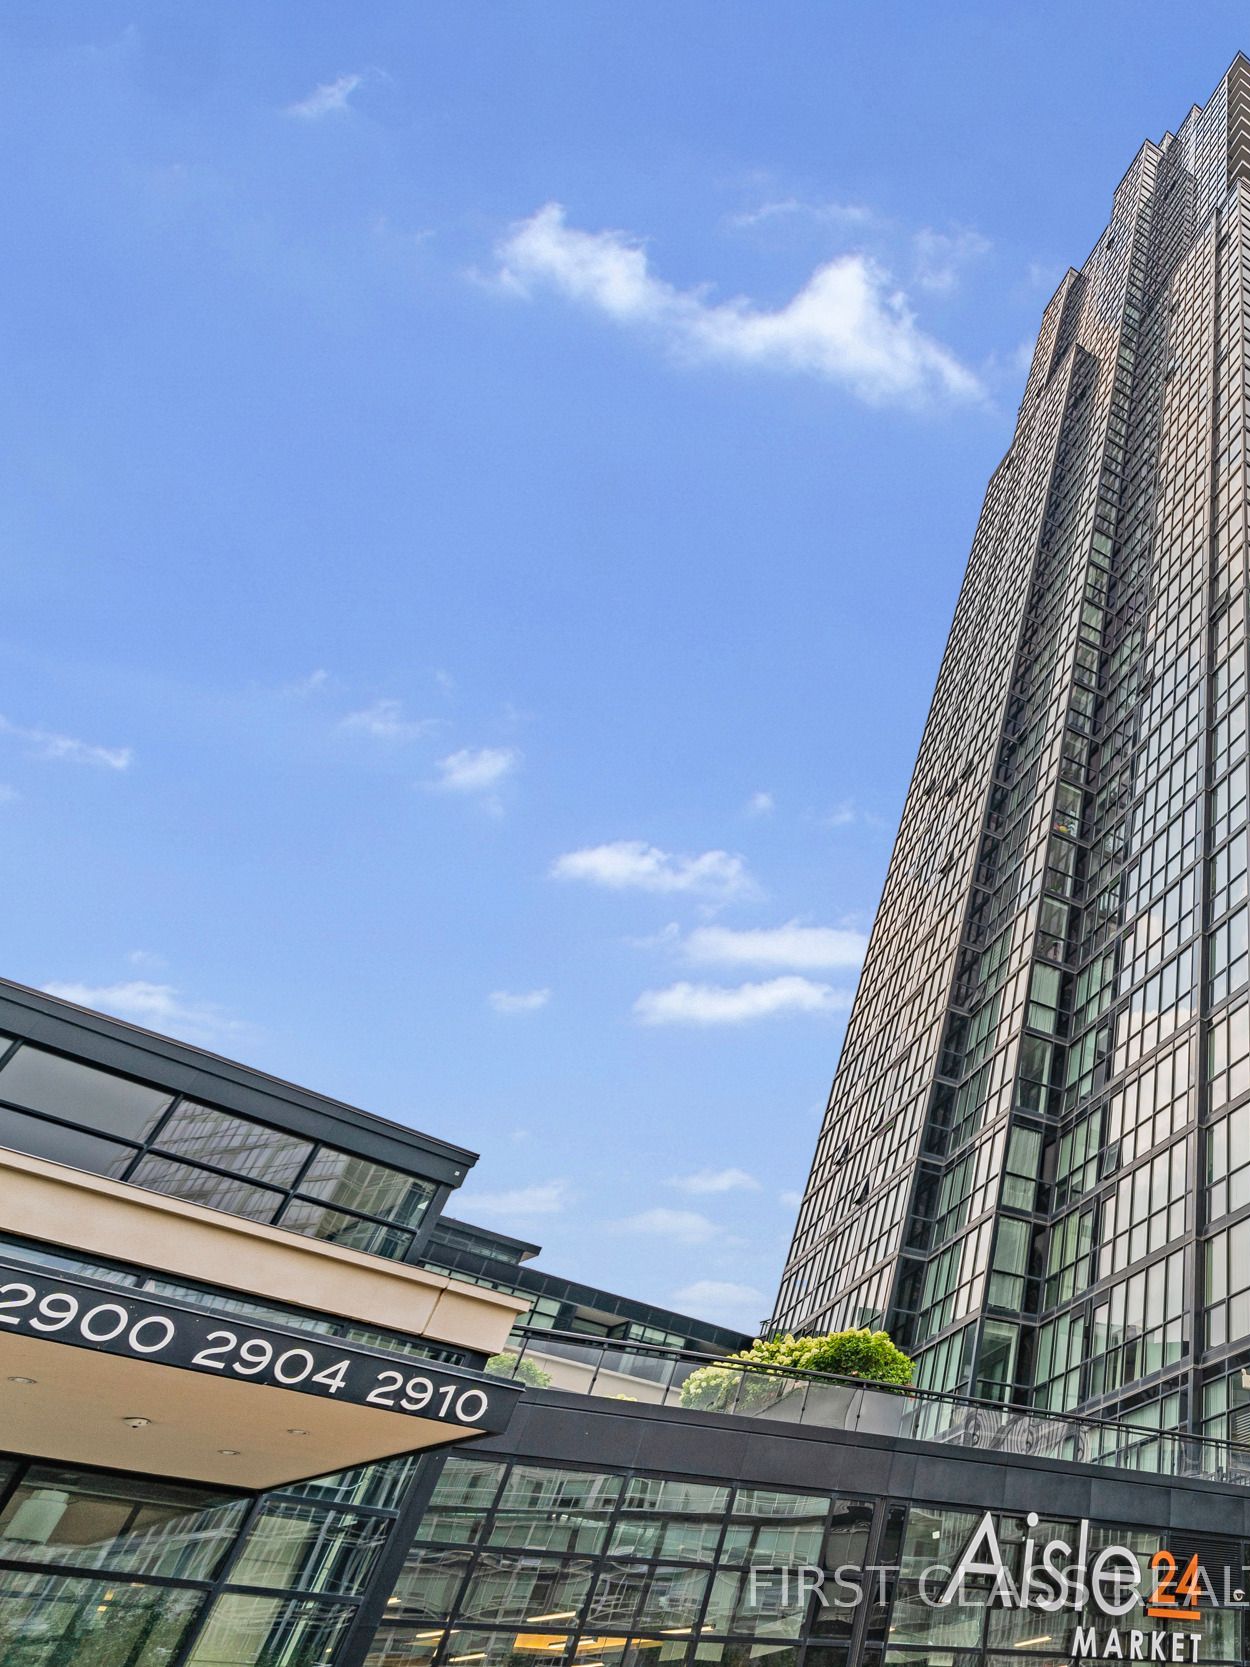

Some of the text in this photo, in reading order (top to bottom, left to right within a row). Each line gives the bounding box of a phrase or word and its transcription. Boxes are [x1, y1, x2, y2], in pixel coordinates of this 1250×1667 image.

[0, 1283, 488, 1422] 2900 2904 2910
[940, 1511, 1198, 1616] Aisle 24
[1071, 1626, 1202, 1664] MARKET
